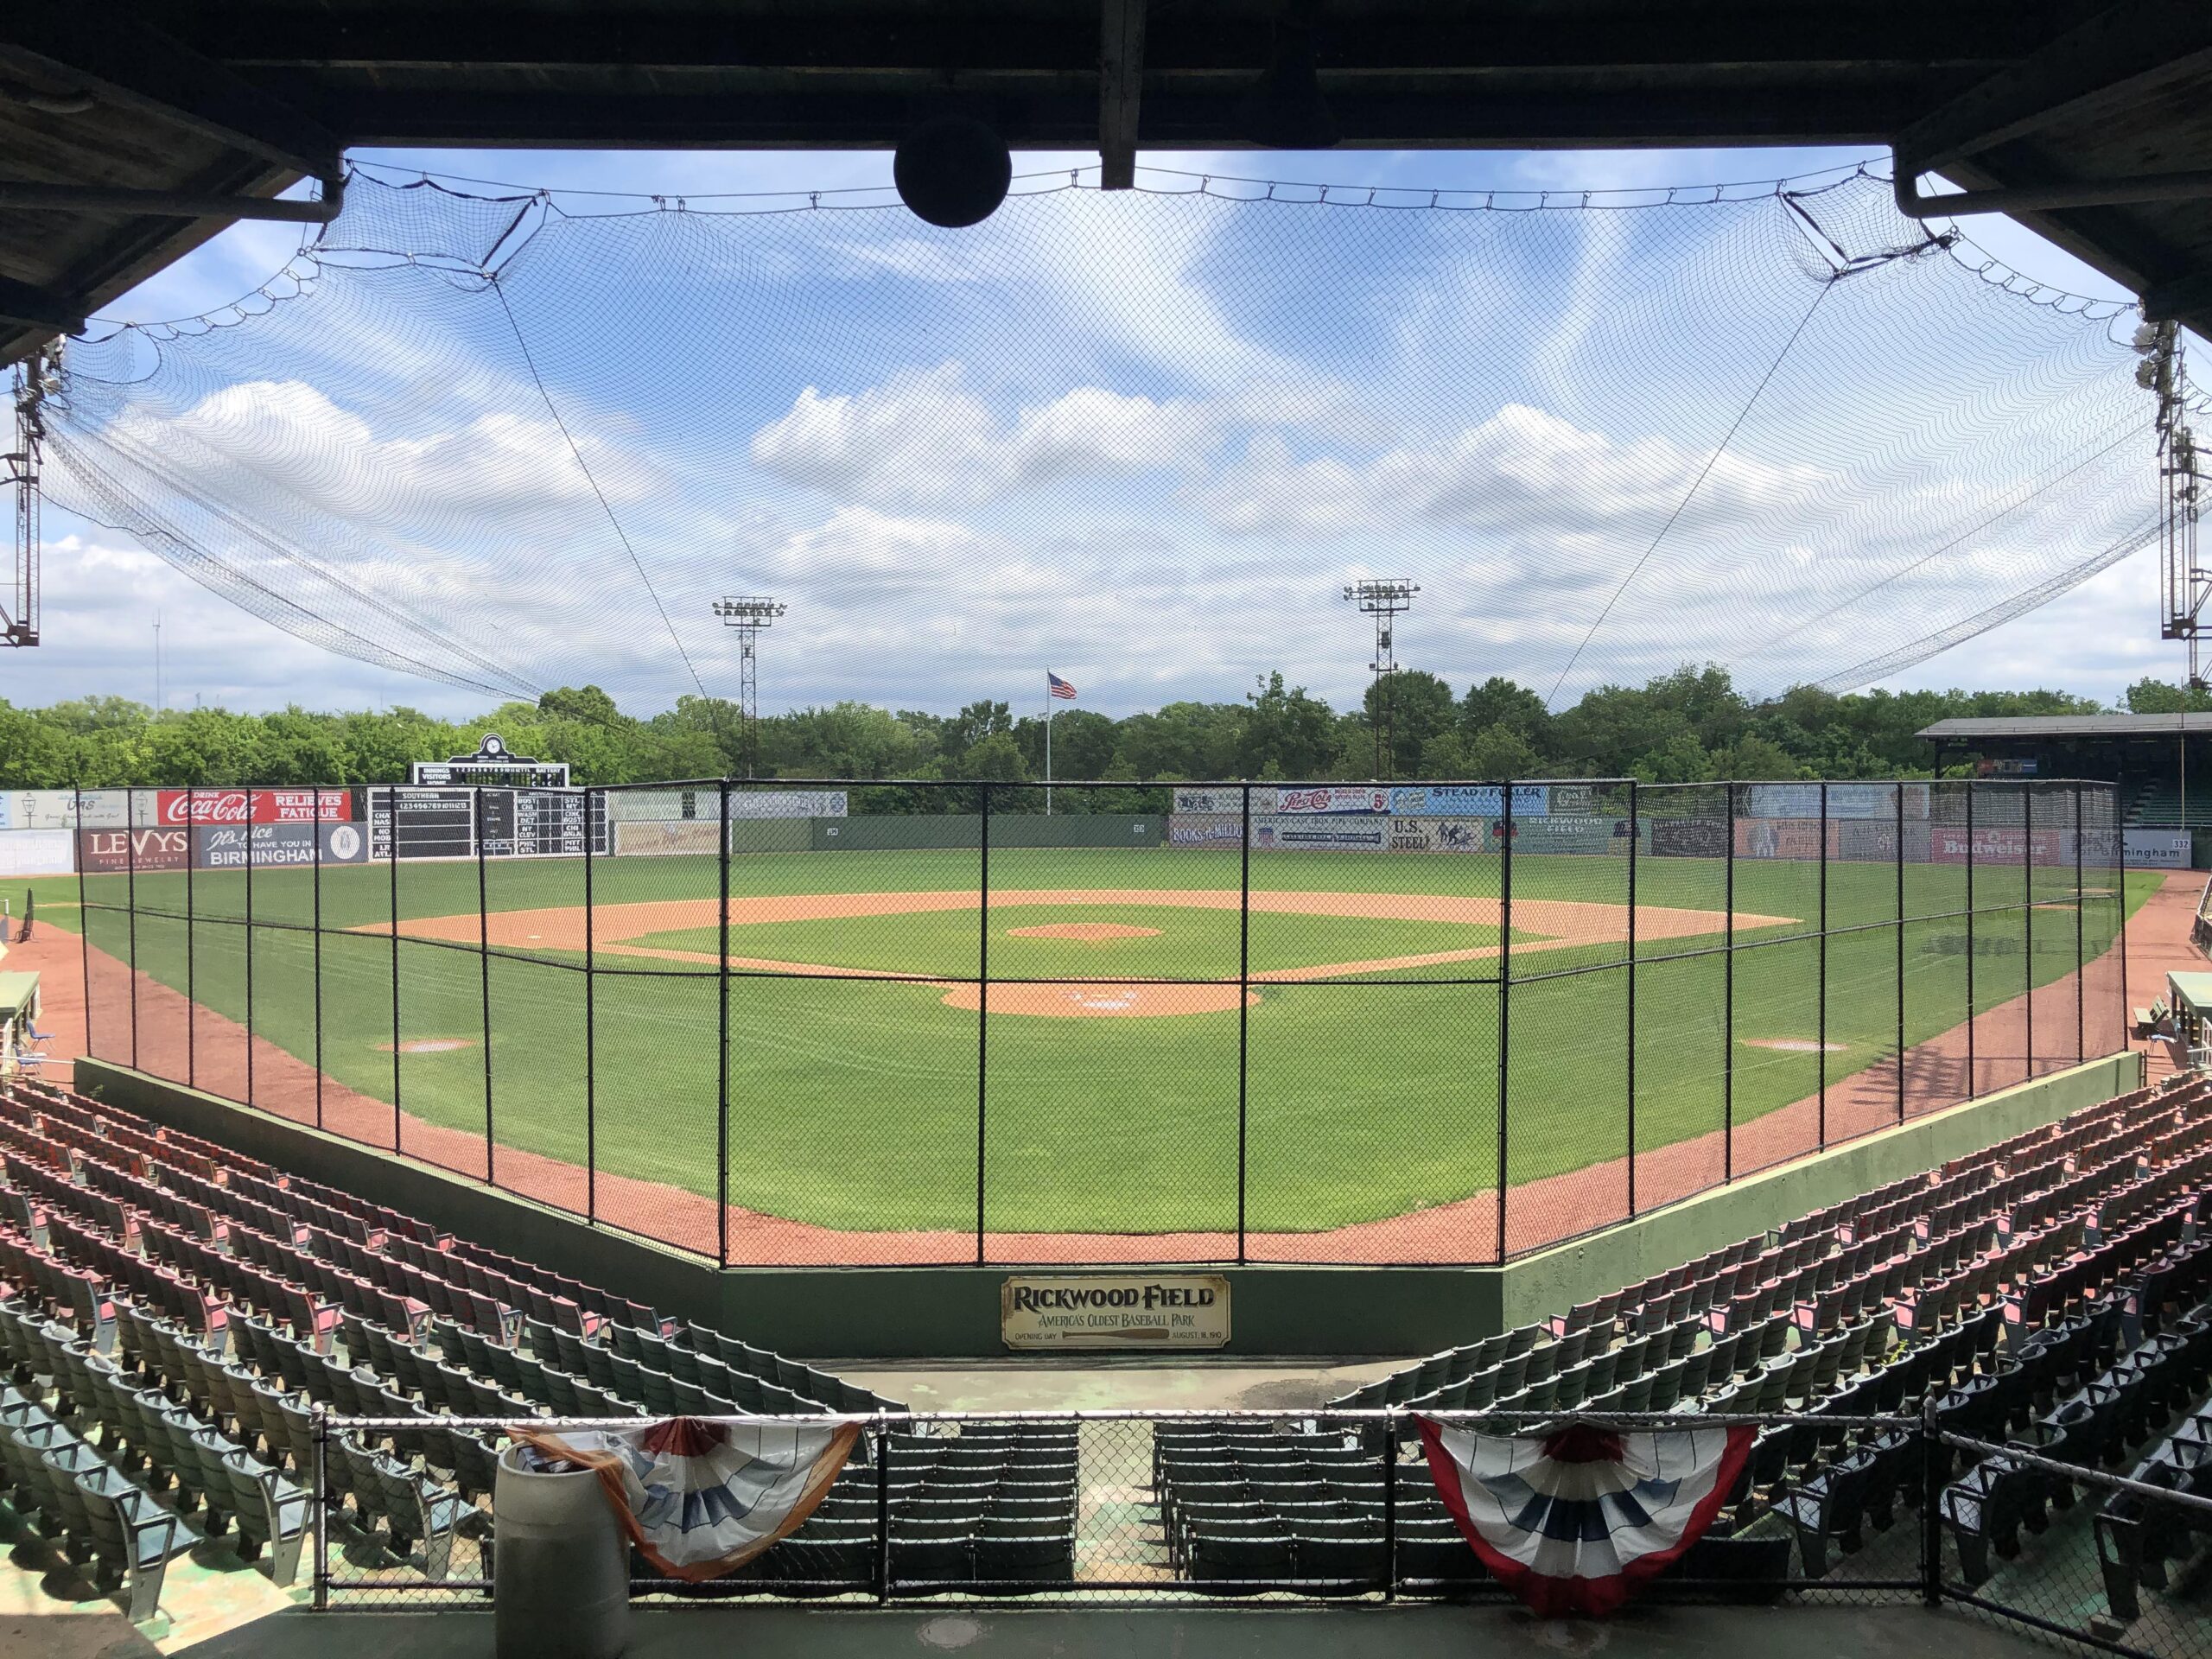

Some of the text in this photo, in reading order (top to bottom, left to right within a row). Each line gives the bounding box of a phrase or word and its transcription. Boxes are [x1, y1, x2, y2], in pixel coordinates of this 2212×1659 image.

[1433, 787, 1478, 797] STEAD
[168, 793, 262, 821] Coca-Cola
[276, 796, 341, 806] RELIEVES
[1394, 820, 1423, 833] U.S.
[1392, 836, 1425, 849] STEEL
[211, 849, 322, 865] BIRMINGHAM
[1014, 1284, 1215, 1313] RICKWOOD FIELD
[1039, 1313, 1195, 1328] AMERICA'S OLDEST BASEBALL PARK
